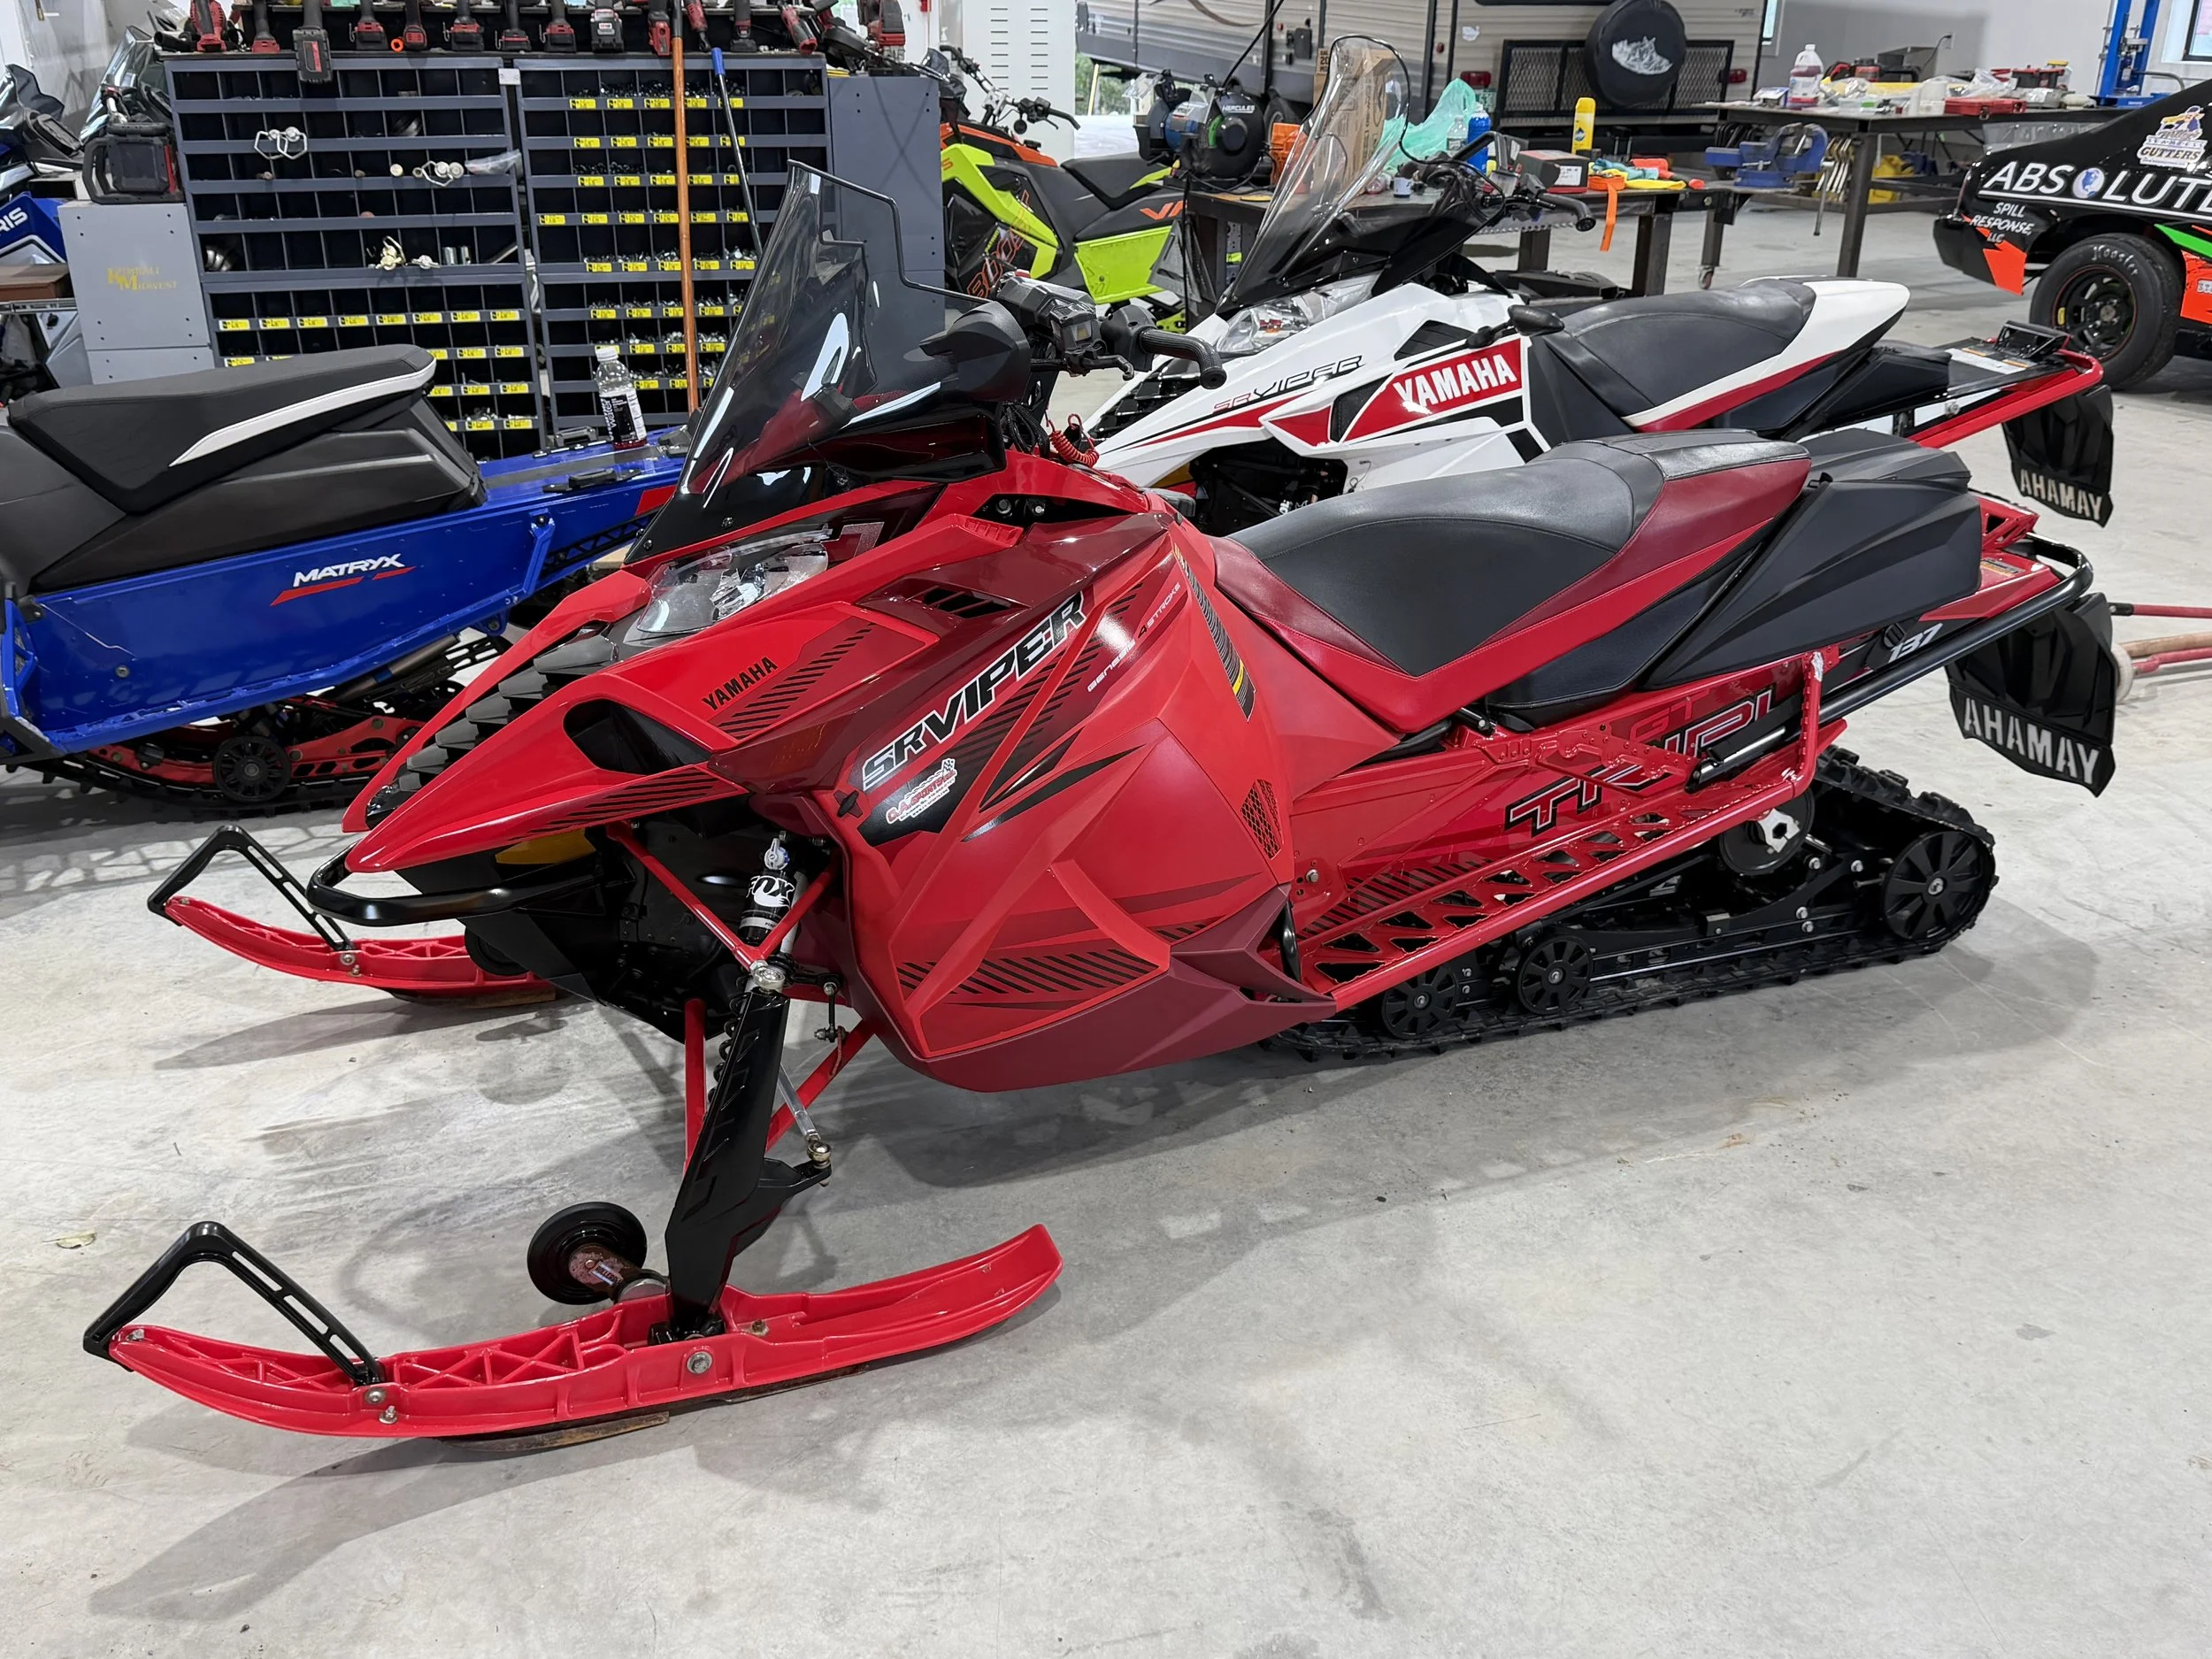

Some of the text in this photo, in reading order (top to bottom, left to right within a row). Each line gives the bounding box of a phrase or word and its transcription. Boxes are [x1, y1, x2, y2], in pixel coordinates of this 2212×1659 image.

[2140, 147, 2200, 159] GUTTERS
[1970, 214, 2034, 236] RESPONSE,
[1993, 202, 2025, 219] SPILL
[1986, 233, 2005, 243] LLC
[1393, 354, 1517, 408] YAMAHA
[293, 553, 405, 588] MATRYX
[1887, 622, 1944, 664] 137
[701, 657, 779, 711] YAMAHA
[746, 875, 795, 904] FOX
